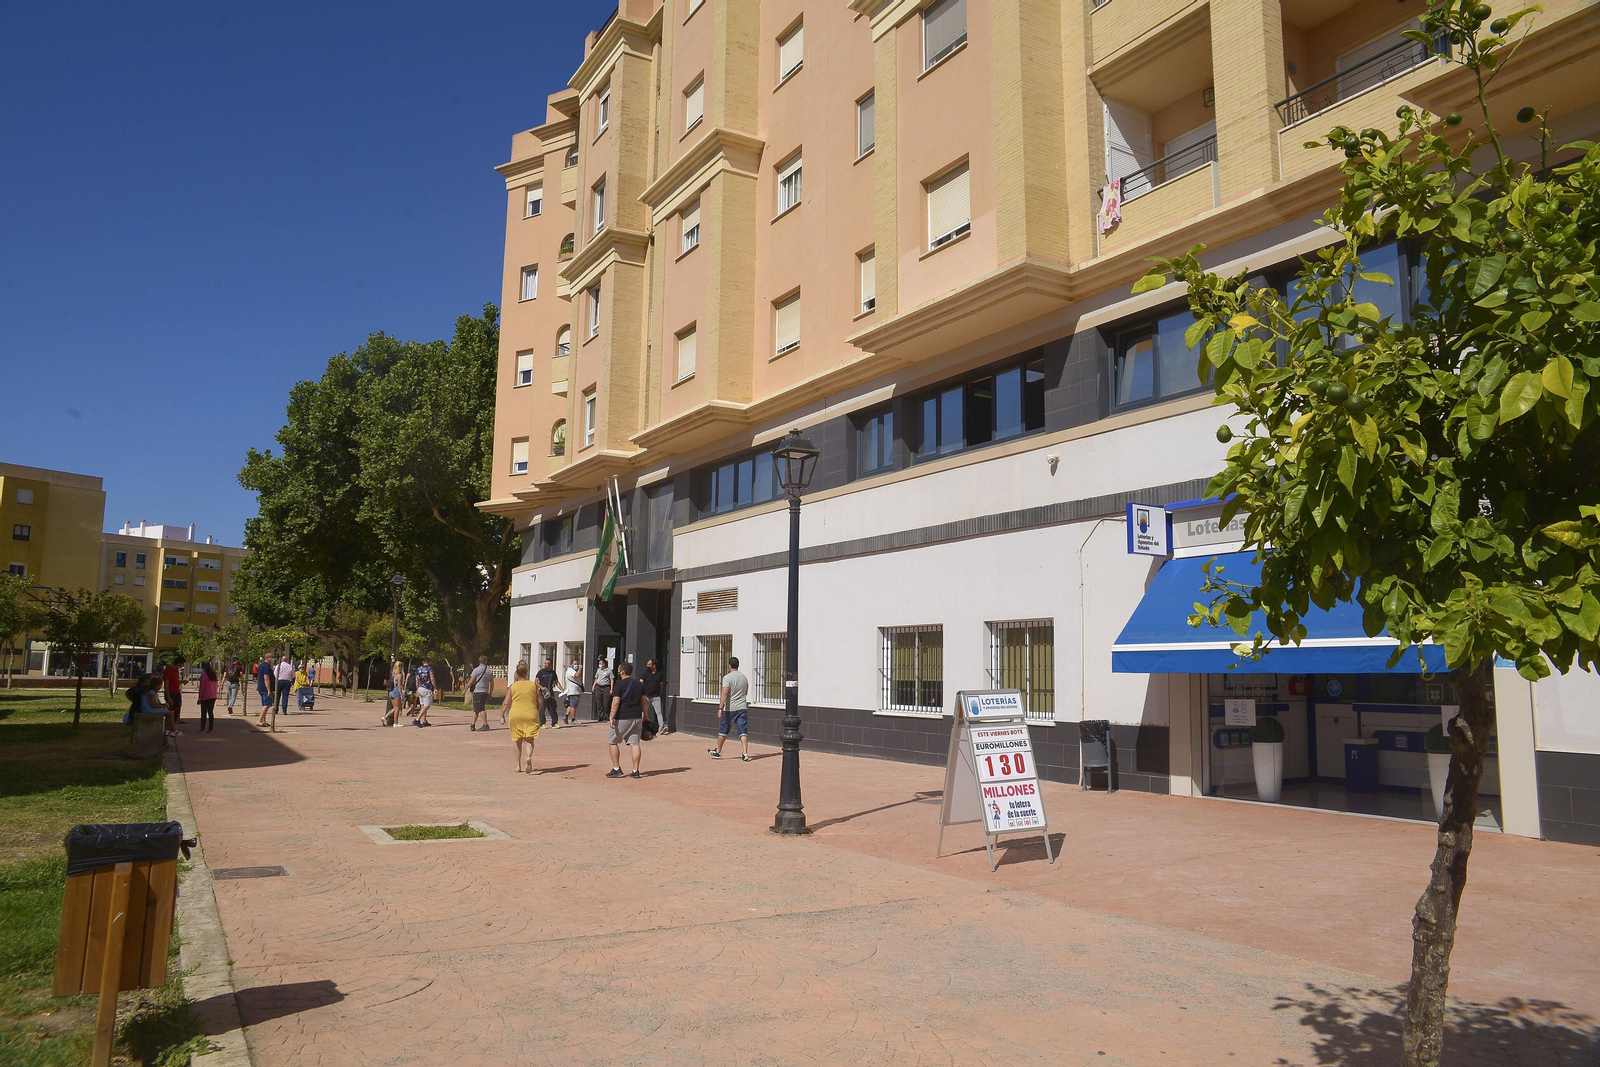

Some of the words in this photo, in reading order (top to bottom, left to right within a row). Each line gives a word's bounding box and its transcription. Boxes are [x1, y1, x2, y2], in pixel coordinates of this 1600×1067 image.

[981, 695, 1017, 705] LOTERÍAS
[975, 740, 1028, 750] EUROMILLONES
[983, 784, 1035, 799] MILLONES
[1015, 800, 1031, 809] lotera
[1007, 810, 1014, 818] de
[1014, 809, 1020, 818] la
[1020, 809, 1037, 817] suerte
